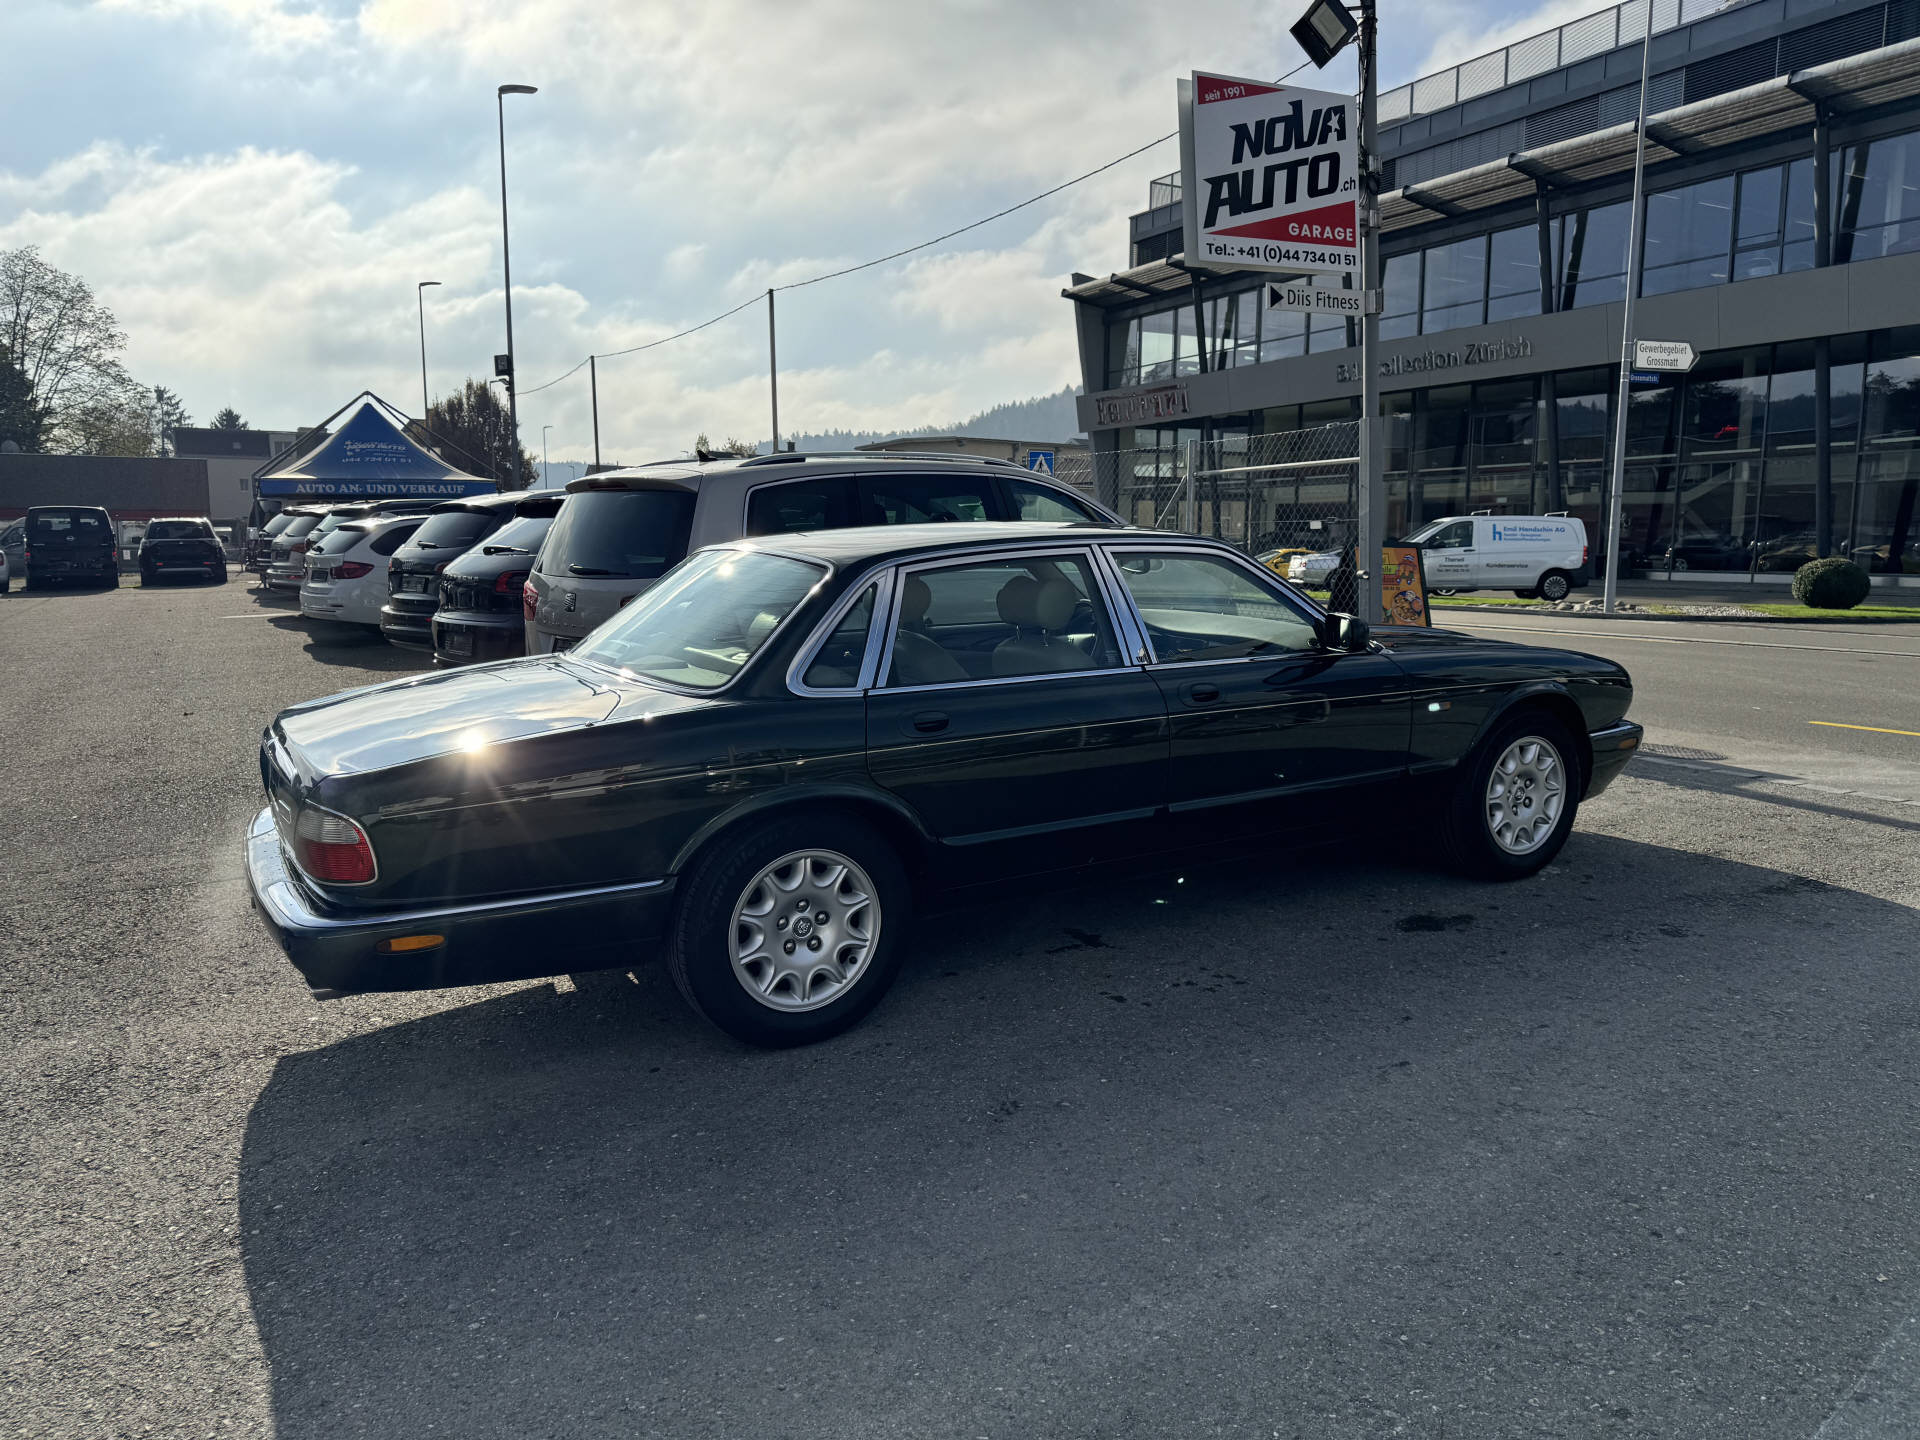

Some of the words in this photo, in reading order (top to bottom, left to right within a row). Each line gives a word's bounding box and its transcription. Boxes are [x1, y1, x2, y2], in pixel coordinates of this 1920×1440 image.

[1204, 89, 1220, 101] seit
[1223, 86, 1245, 98] 1991
[1229, 100, 1347, 165] NOVA
[1203, 152, 1341, 229] AUTO
[1340, 177, 1356, 193] .ch
[1288, 222, 1353, 241] GARAGE
[1206, 243, 1235, 257] Tel.:
[1237, 246, 1260, 259] +41
[1263, 244, 1300, 263] (0)44
[1303, 250, 1326, 264] 734
[1328, 253, 1341, 265] 01
[1344, 254, 1356, 267] 51
[1287, 289, 1311, 307] Diis
[1316, 291, 1359, 310] Fitness
[1639, 343, 1688, 356] Gewerbegebiet
[1378, 350, 1460, 377] ollection
[1646, 356, 1679, 367] Grossmatt
[295, 484, 335, 493] AUTO
[366, 484, 397, 494] UND
[400, 484, 465, 494] VERKAUF
